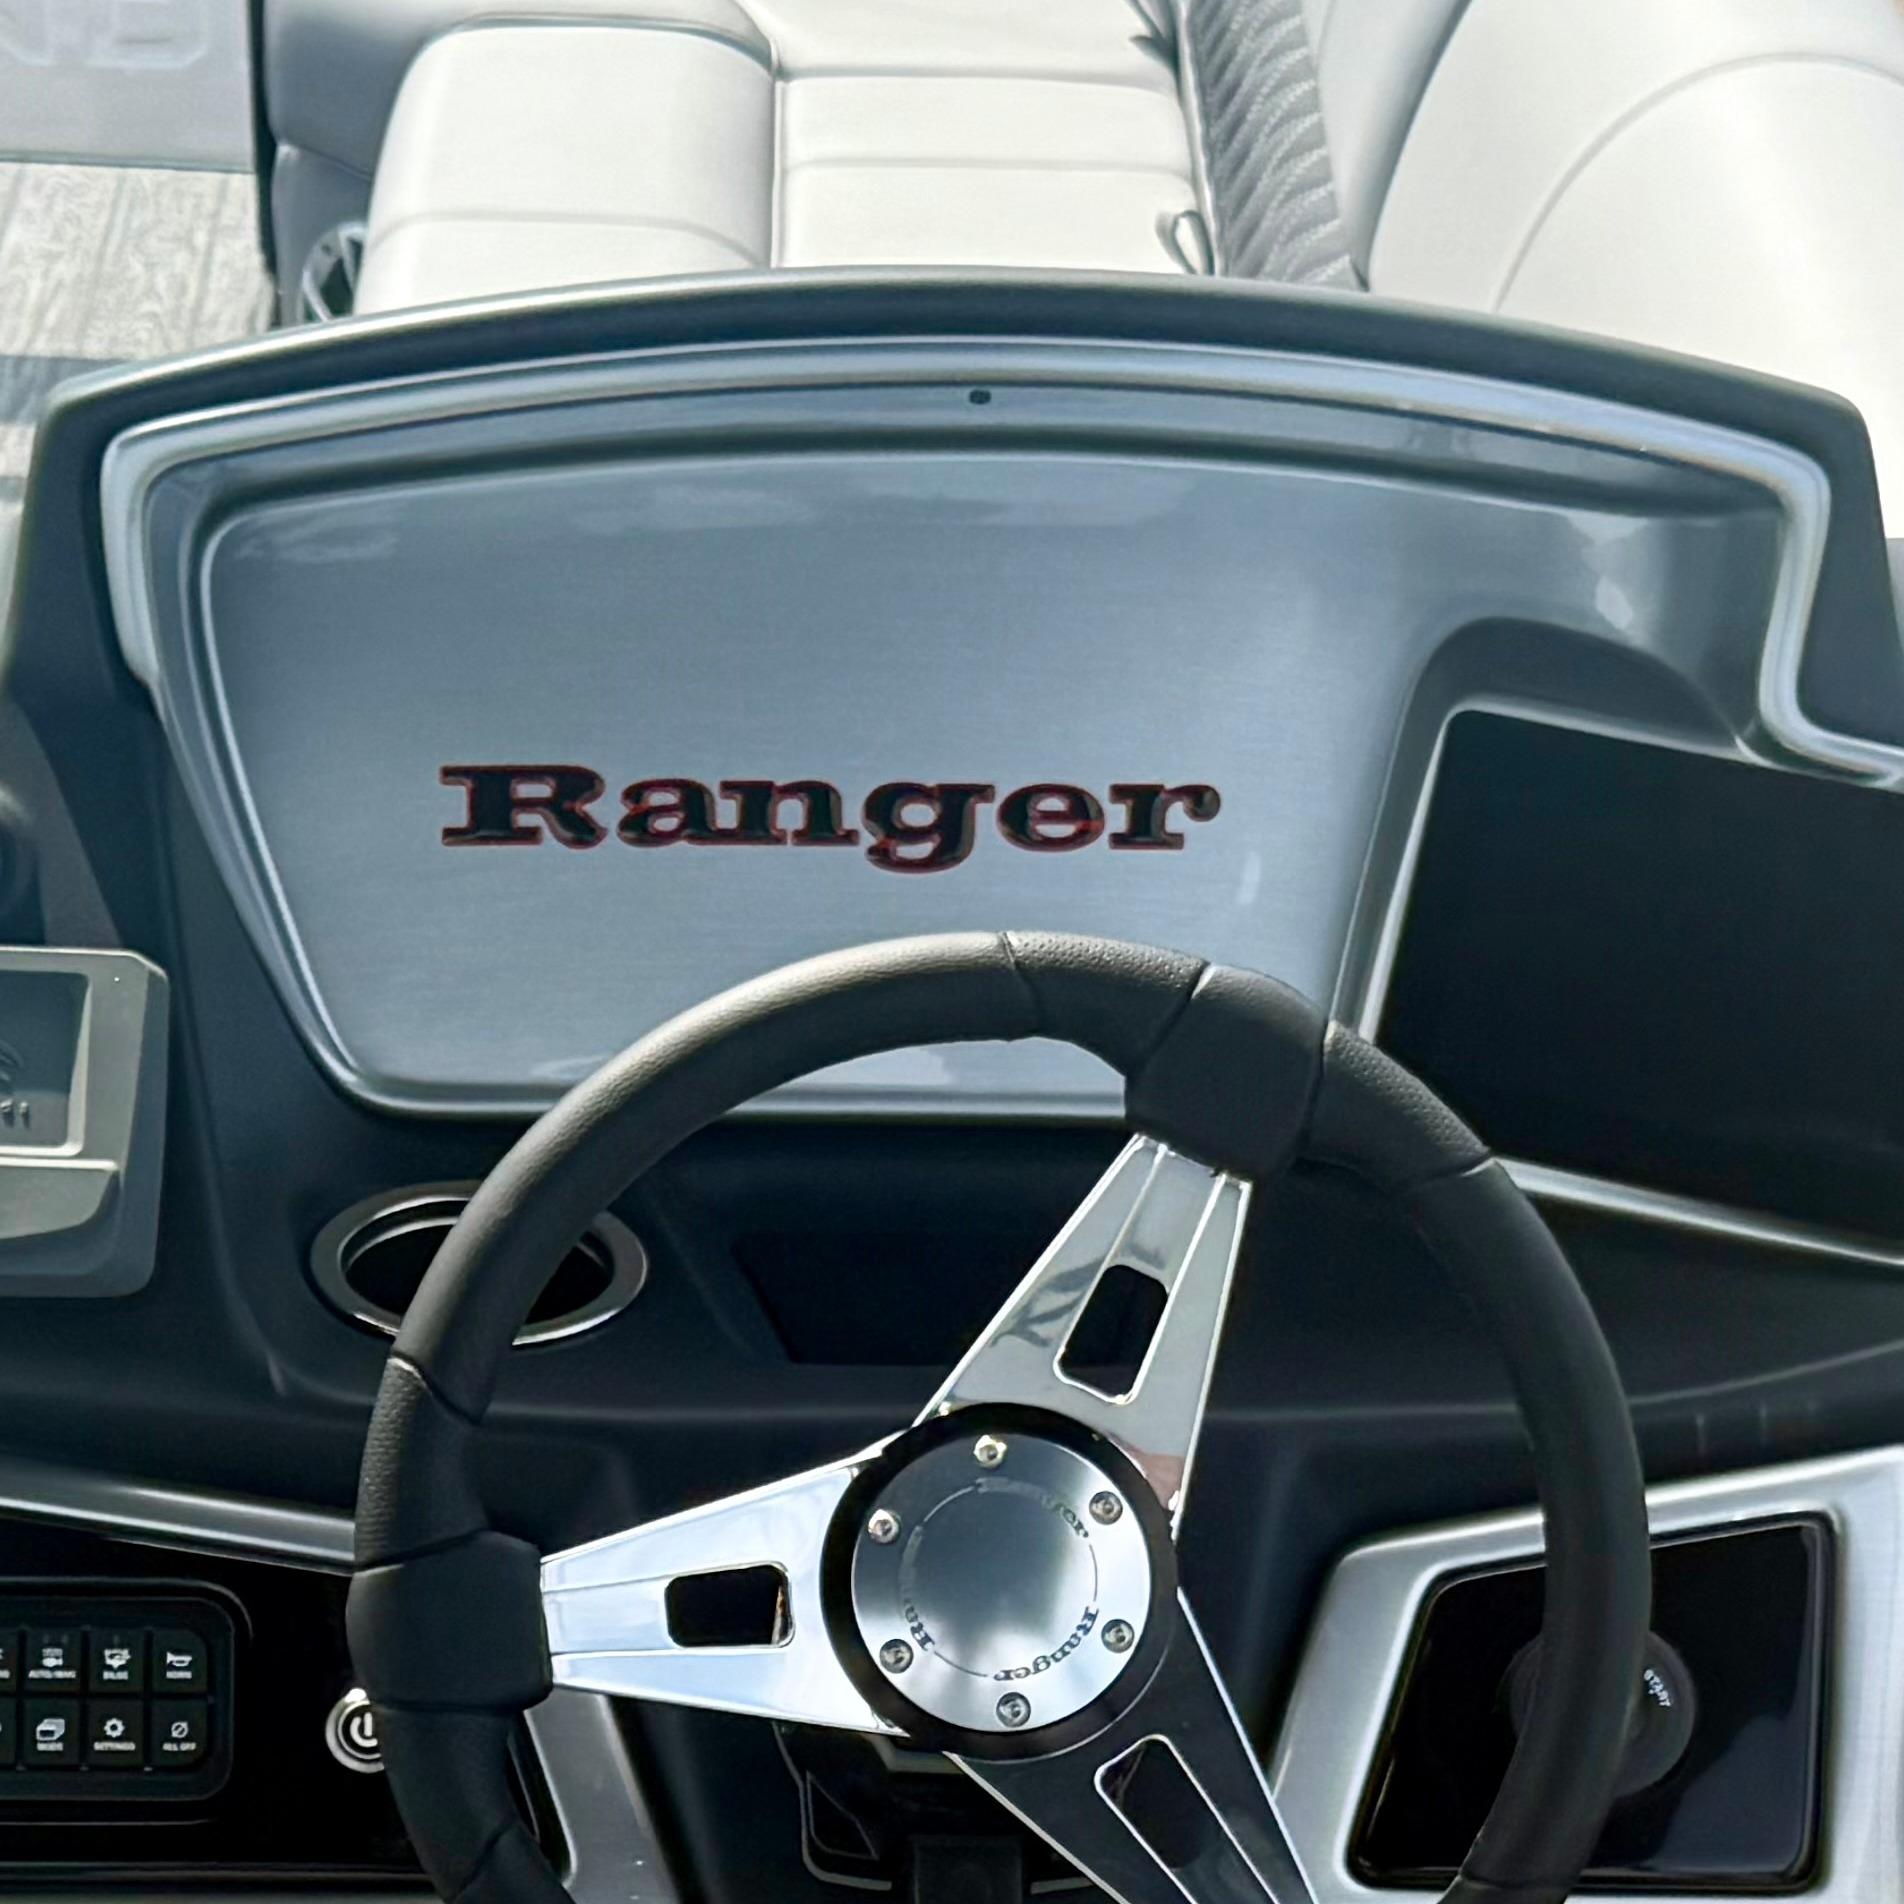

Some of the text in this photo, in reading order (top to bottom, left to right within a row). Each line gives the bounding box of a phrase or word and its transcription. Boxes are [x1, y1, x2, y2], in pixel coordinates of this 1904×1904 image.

[439, 763, 1223, 875] Ranger
[992, 1605, 1100, 1682] Ranger
[1643, 1668, 1672, 1707] START
